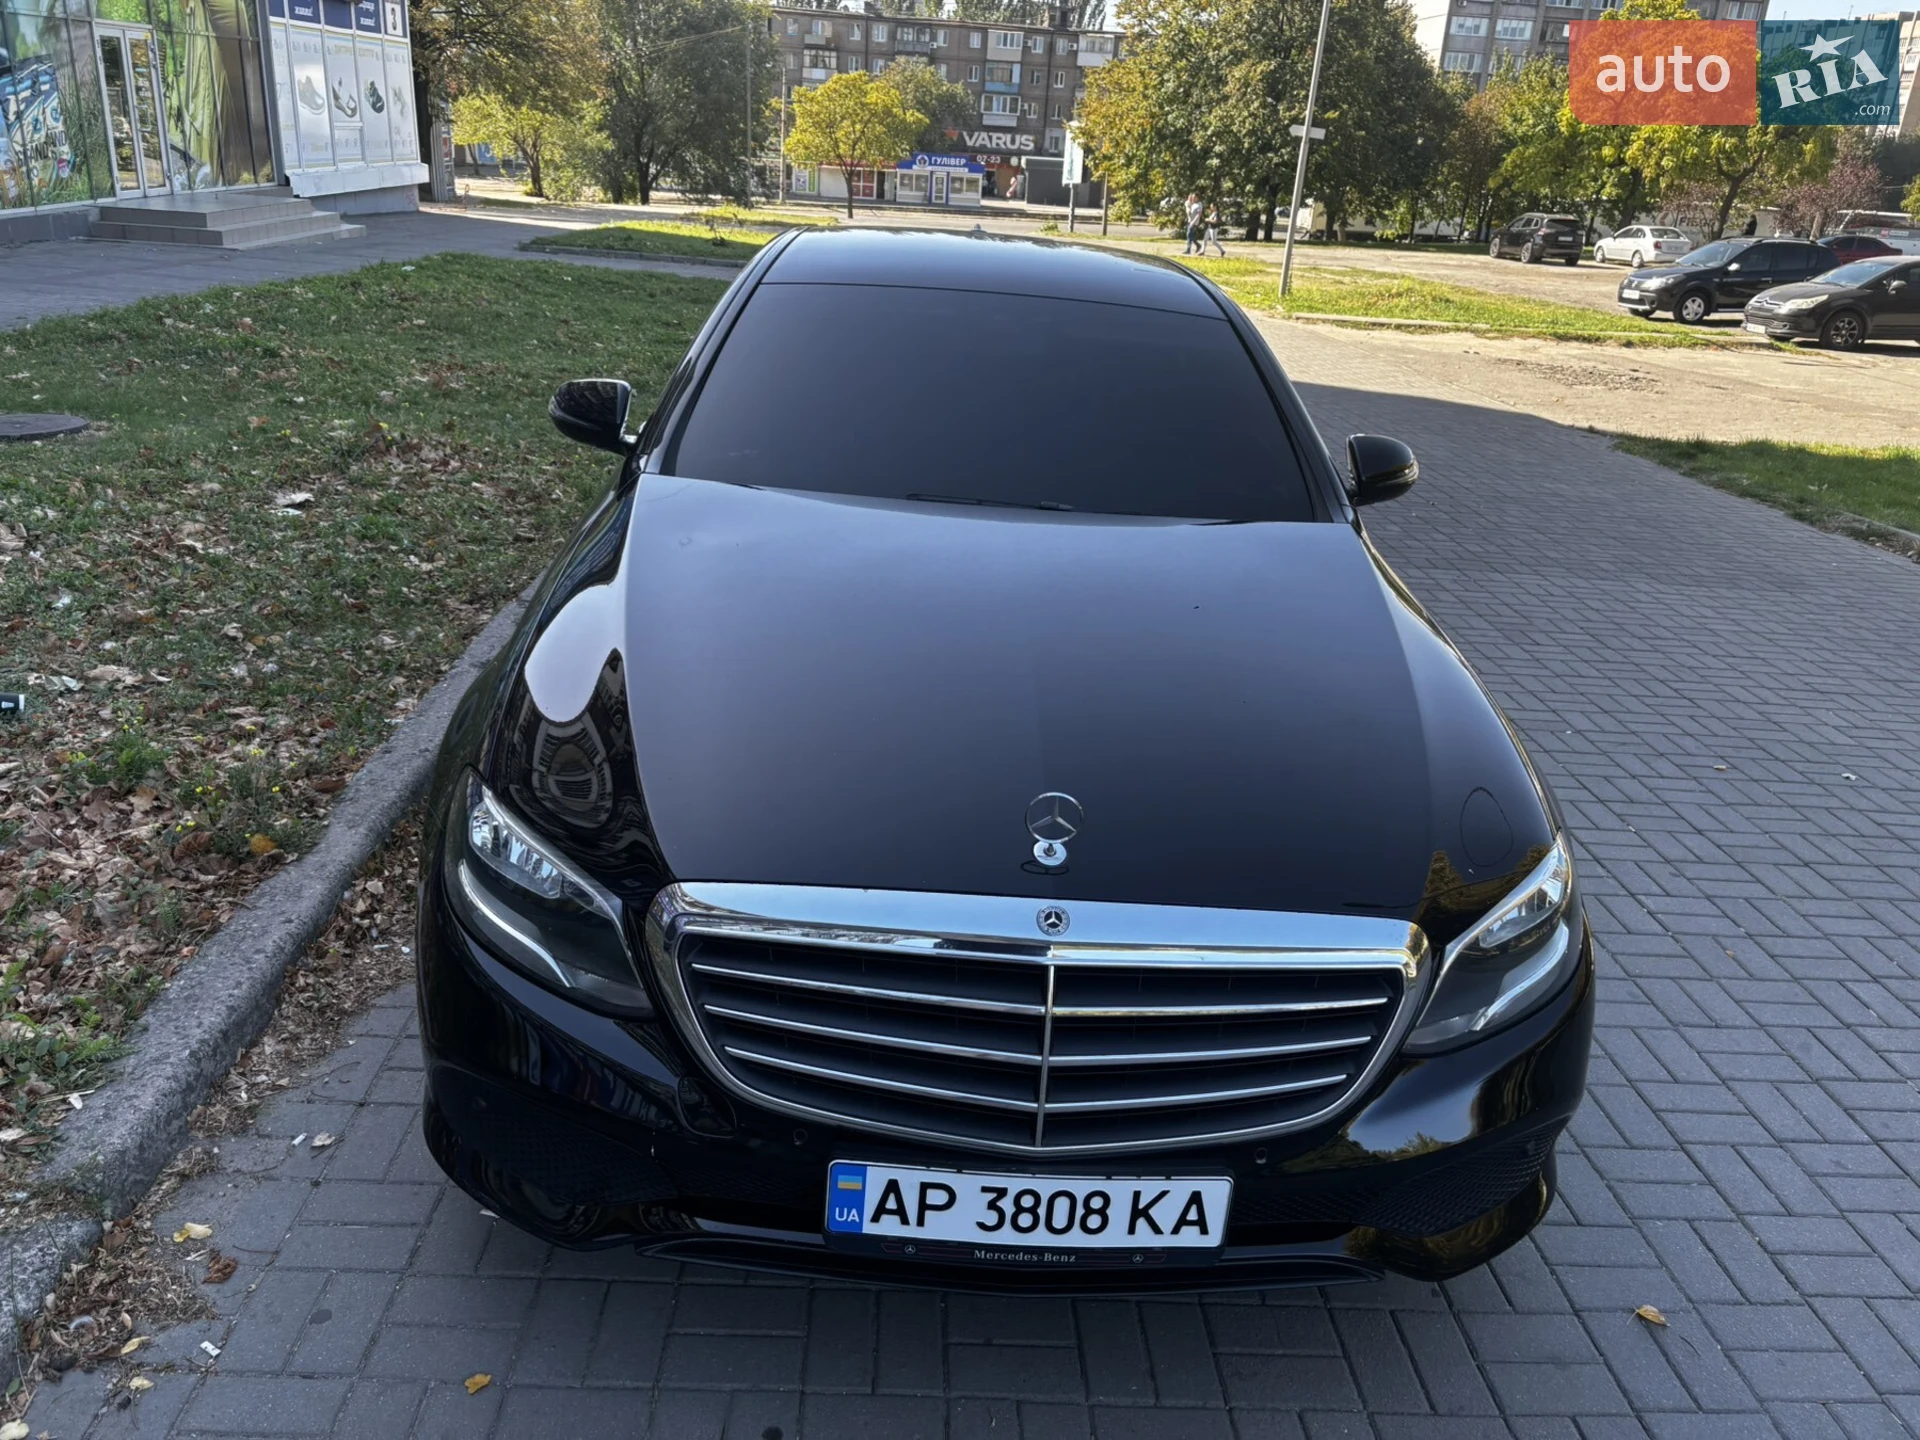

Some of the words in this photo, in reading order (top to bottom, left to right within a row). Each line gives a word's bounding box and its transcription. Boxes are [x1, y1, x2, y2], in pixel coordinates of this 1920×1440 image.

[962, 131, 1035, 151] VARUS
[931, 156, 967, 166] ГУЛІВЕР
[976, 154, 1001, 164] 07-23
[835, 1207, 860, 1223] UA
[869, 1178, 957, 1228] AP
[975, 1186, 1112, 1236] 3808
[1127, 1190, 1209, 1236] KA
[973, 1249, 1077, 1264] Mercedes-Benz
